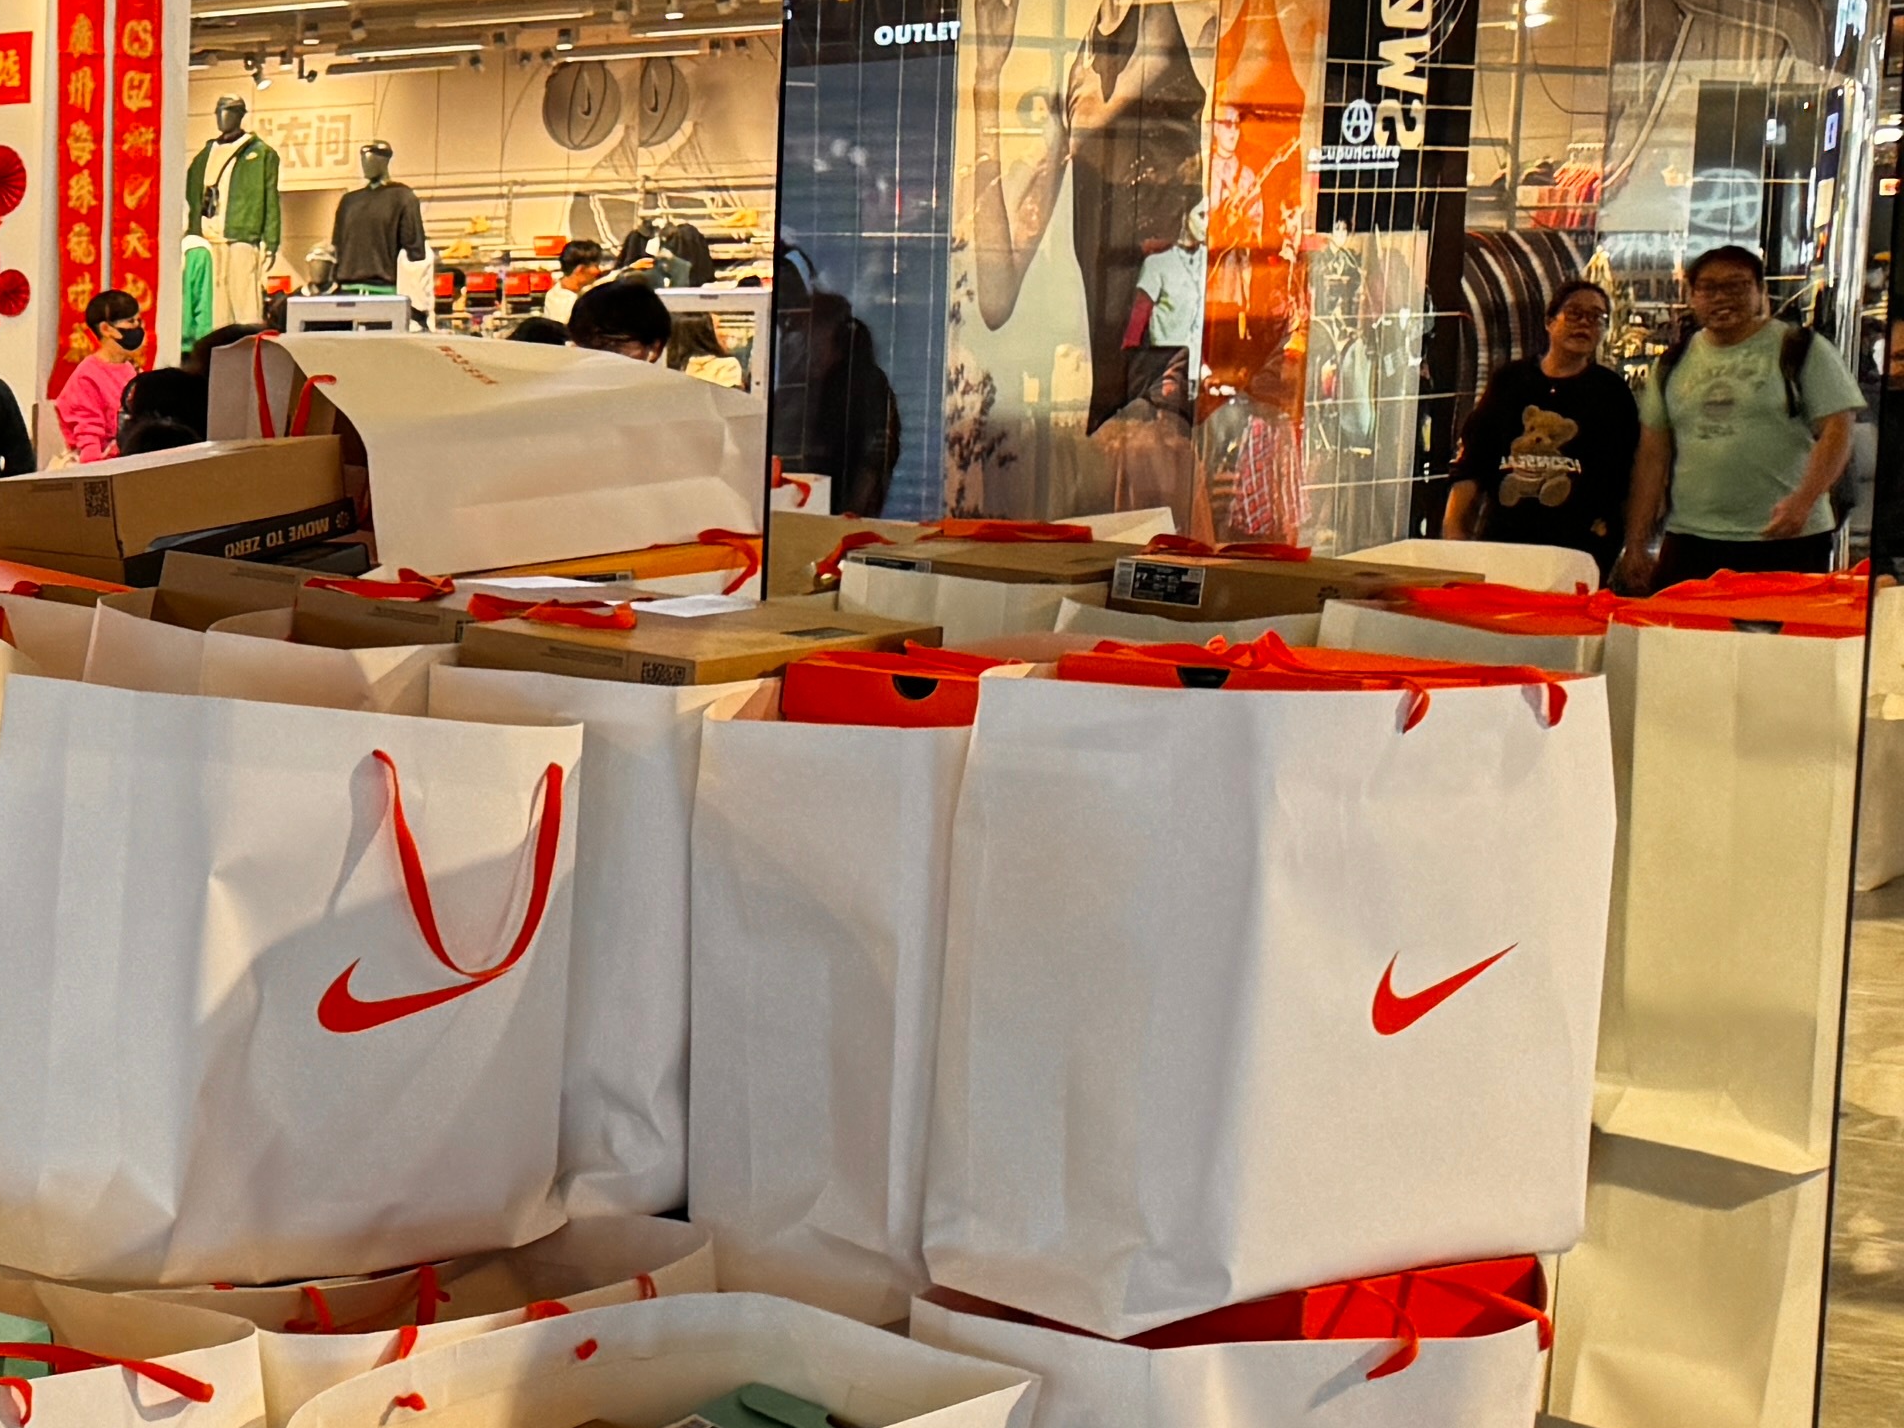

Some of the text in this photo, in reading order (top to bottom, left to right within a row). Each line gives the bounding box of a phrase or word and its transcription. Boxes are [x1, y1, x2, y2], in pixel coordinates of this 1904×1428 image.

[874, 22, 960, 47] OUTLET
[224, 517, 330, 558] MOVE TO ZERO
